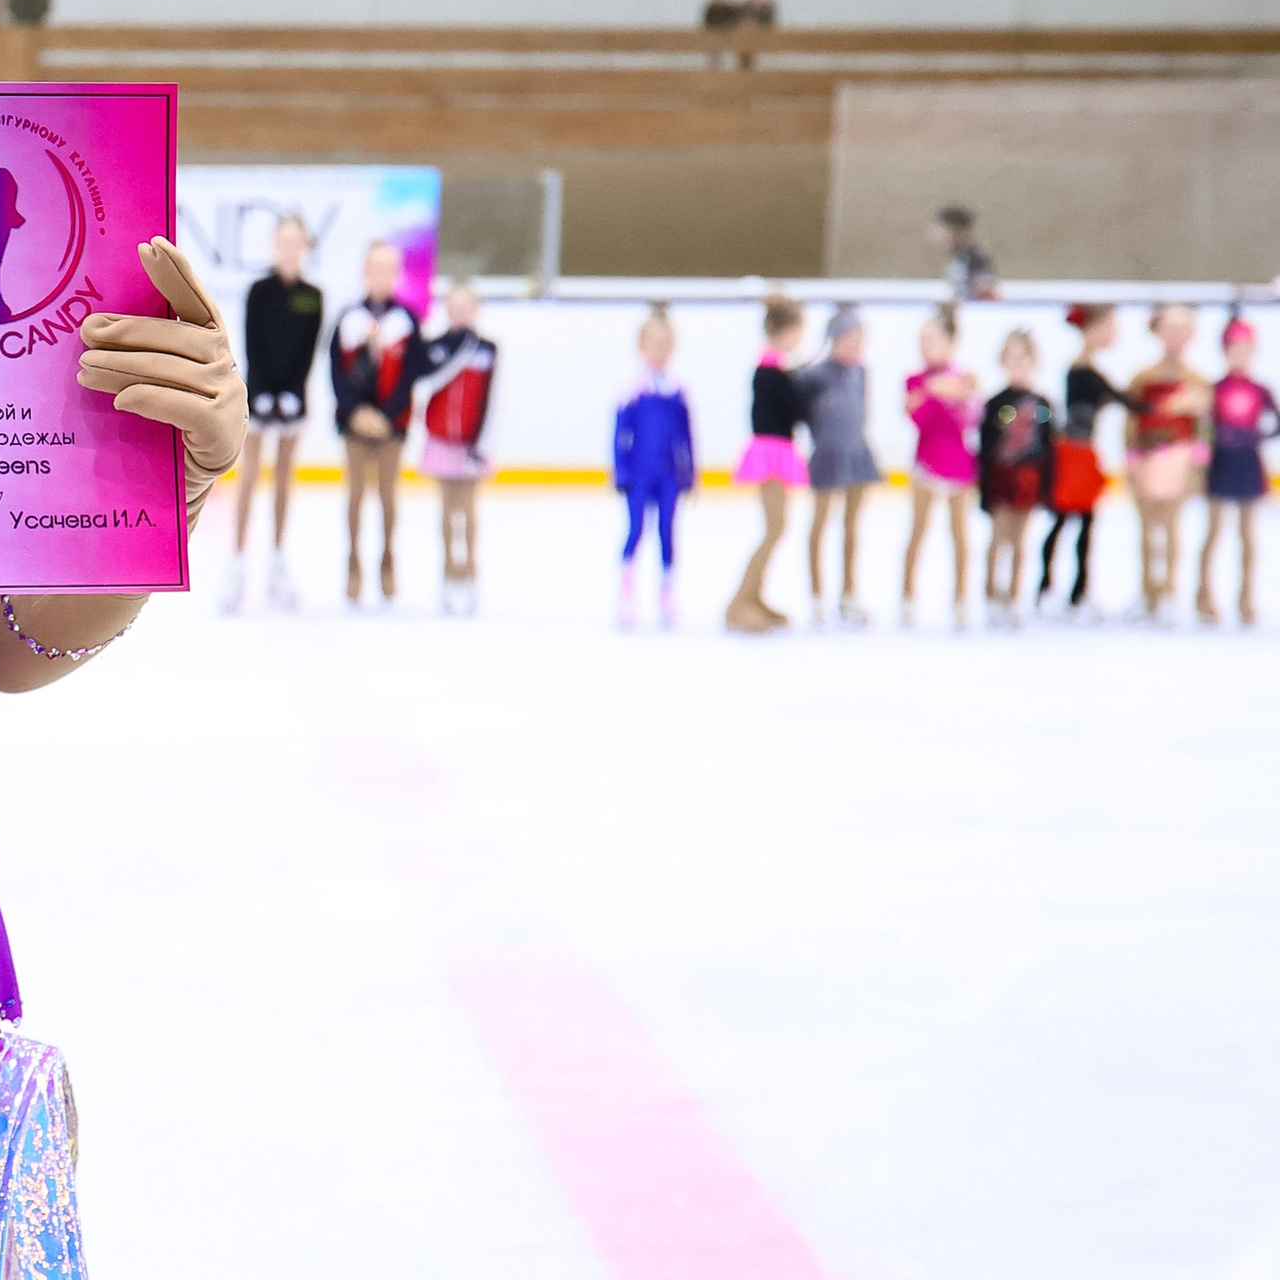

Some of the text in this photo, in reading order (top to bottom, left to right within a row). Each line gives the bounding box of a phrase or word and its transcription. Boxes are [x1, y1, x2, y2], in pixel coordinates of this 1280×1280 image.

[68, 150, 106, 222] КАТАНИЮ
[0, 276, 104, 359] CANDY
[21, 406, 32, 421] и
[9, 508, 157, 529] Усачева И.А.
